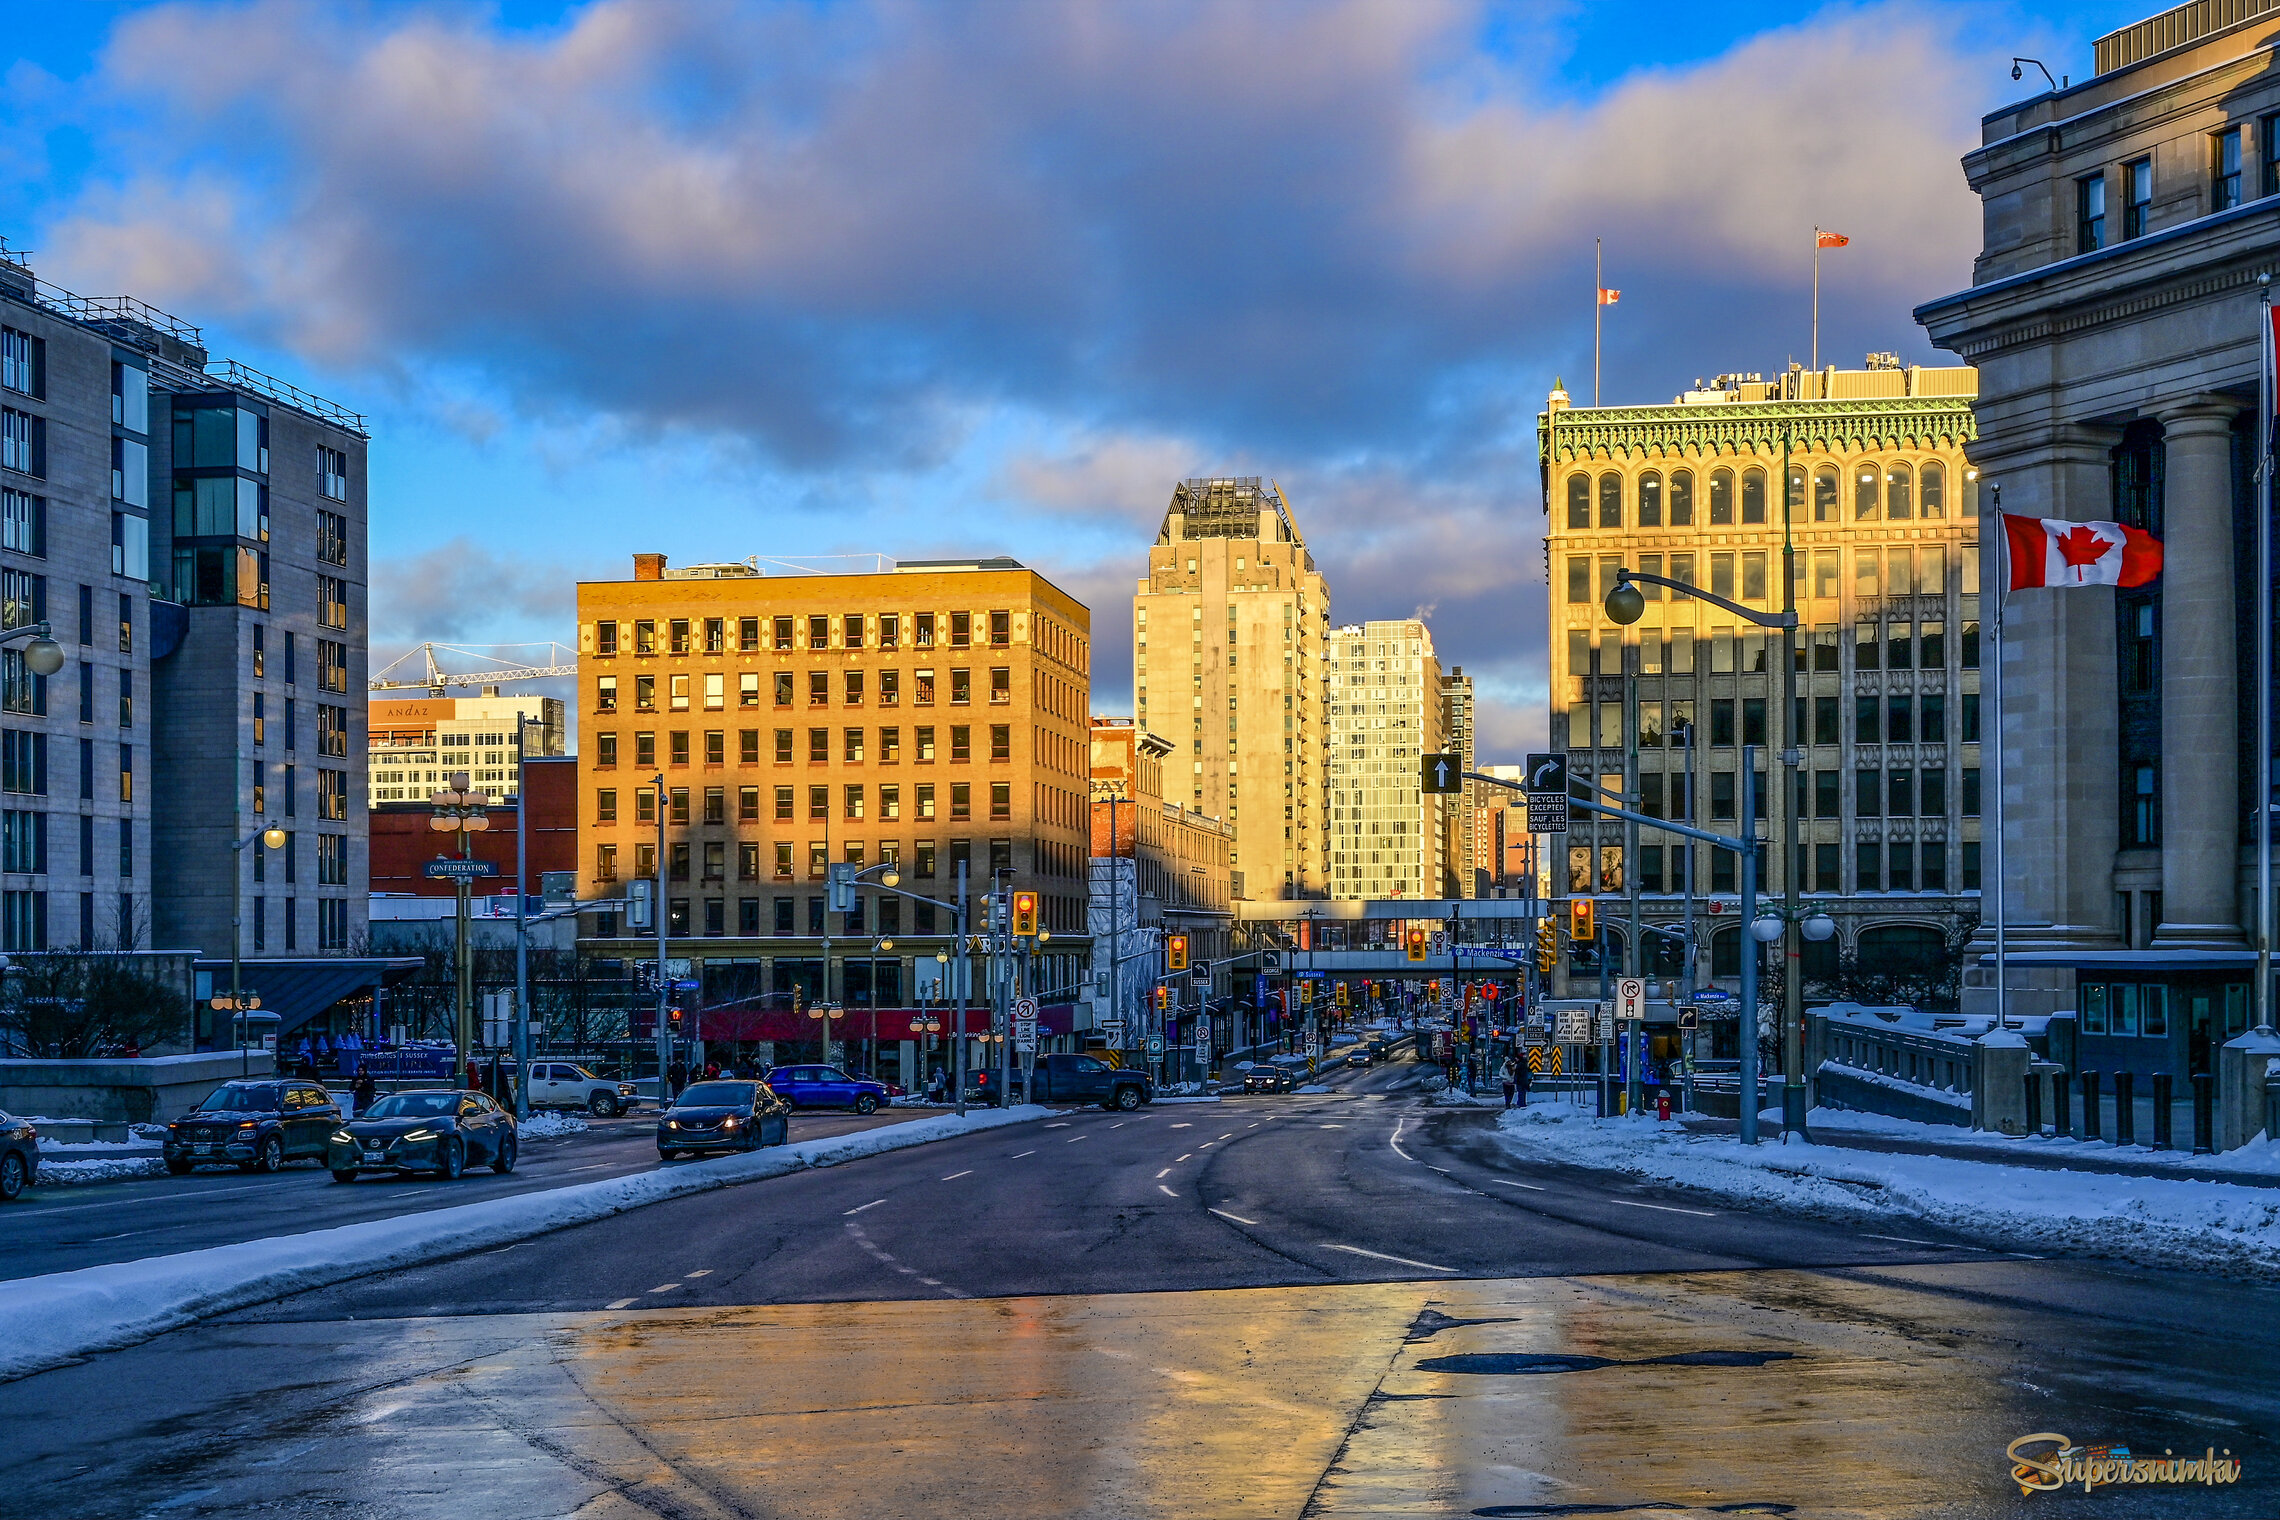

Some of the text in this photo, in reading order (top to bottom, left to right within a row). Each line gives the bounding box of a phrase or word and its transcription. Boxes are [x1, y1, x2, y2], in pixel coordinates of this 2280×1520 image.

[1090, 780, 1128, 793] BAY
[429, 864, 489, 875] CONFEDERATION
[1467, 949, 1504, 958] Mackenzie
